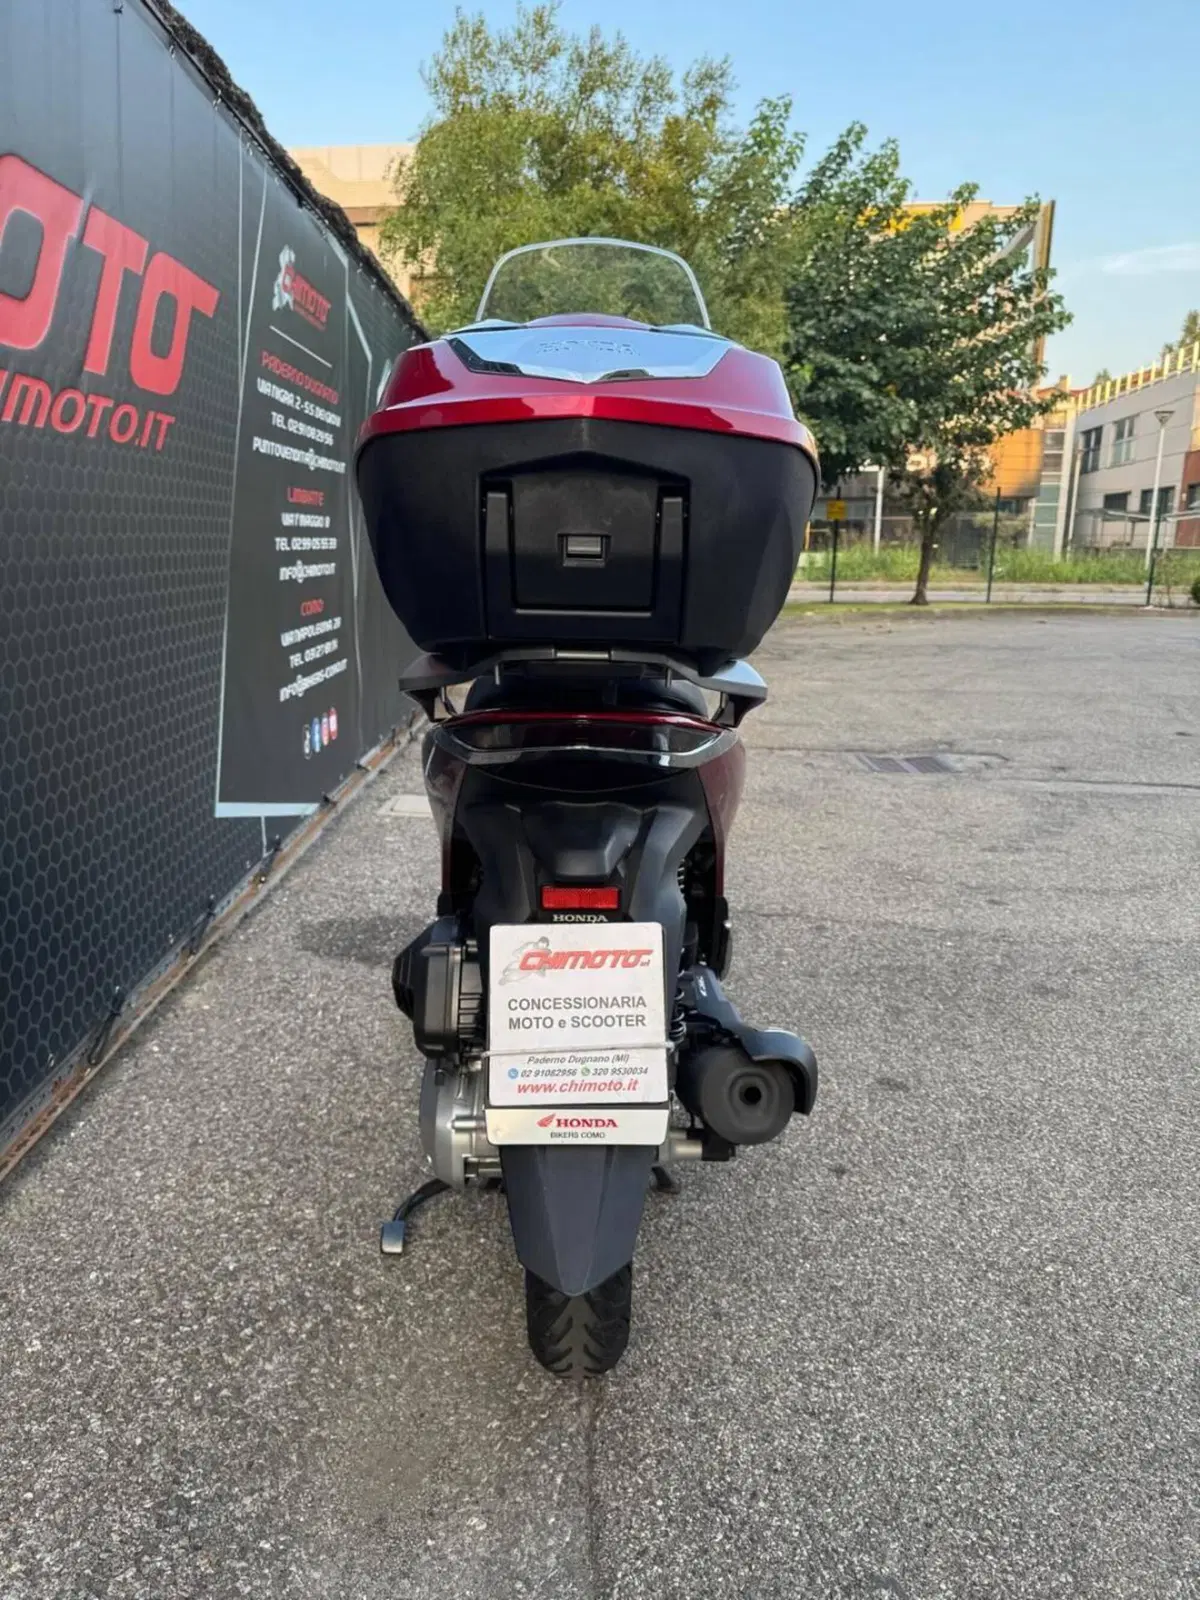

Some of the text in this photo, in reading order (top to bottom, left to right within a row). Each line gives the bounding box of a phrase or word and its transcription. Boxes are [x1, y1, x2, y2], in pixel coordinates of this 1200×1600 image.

[552, 914, 609, 923] HONDA
[519, 949, 654, 971] CHIMOTO
[507, 995, 647, 1012] CONCESSIONARIA
[508, 1014, 646, 1030] MOTO e SCOOTER
[527, 1055, 566, 1065] Paderno
[568, 1055, 610, 1065] Dugnano
[520, 1069, 532, 1078] 02
[592, 1067, 609, 1077] 320
[517, 1078, 640, 1094] www.chimoto.it
[555, 1118, 618, 1128] HONDA
[550, 1131, 606, 1139] BIKERS COMO
